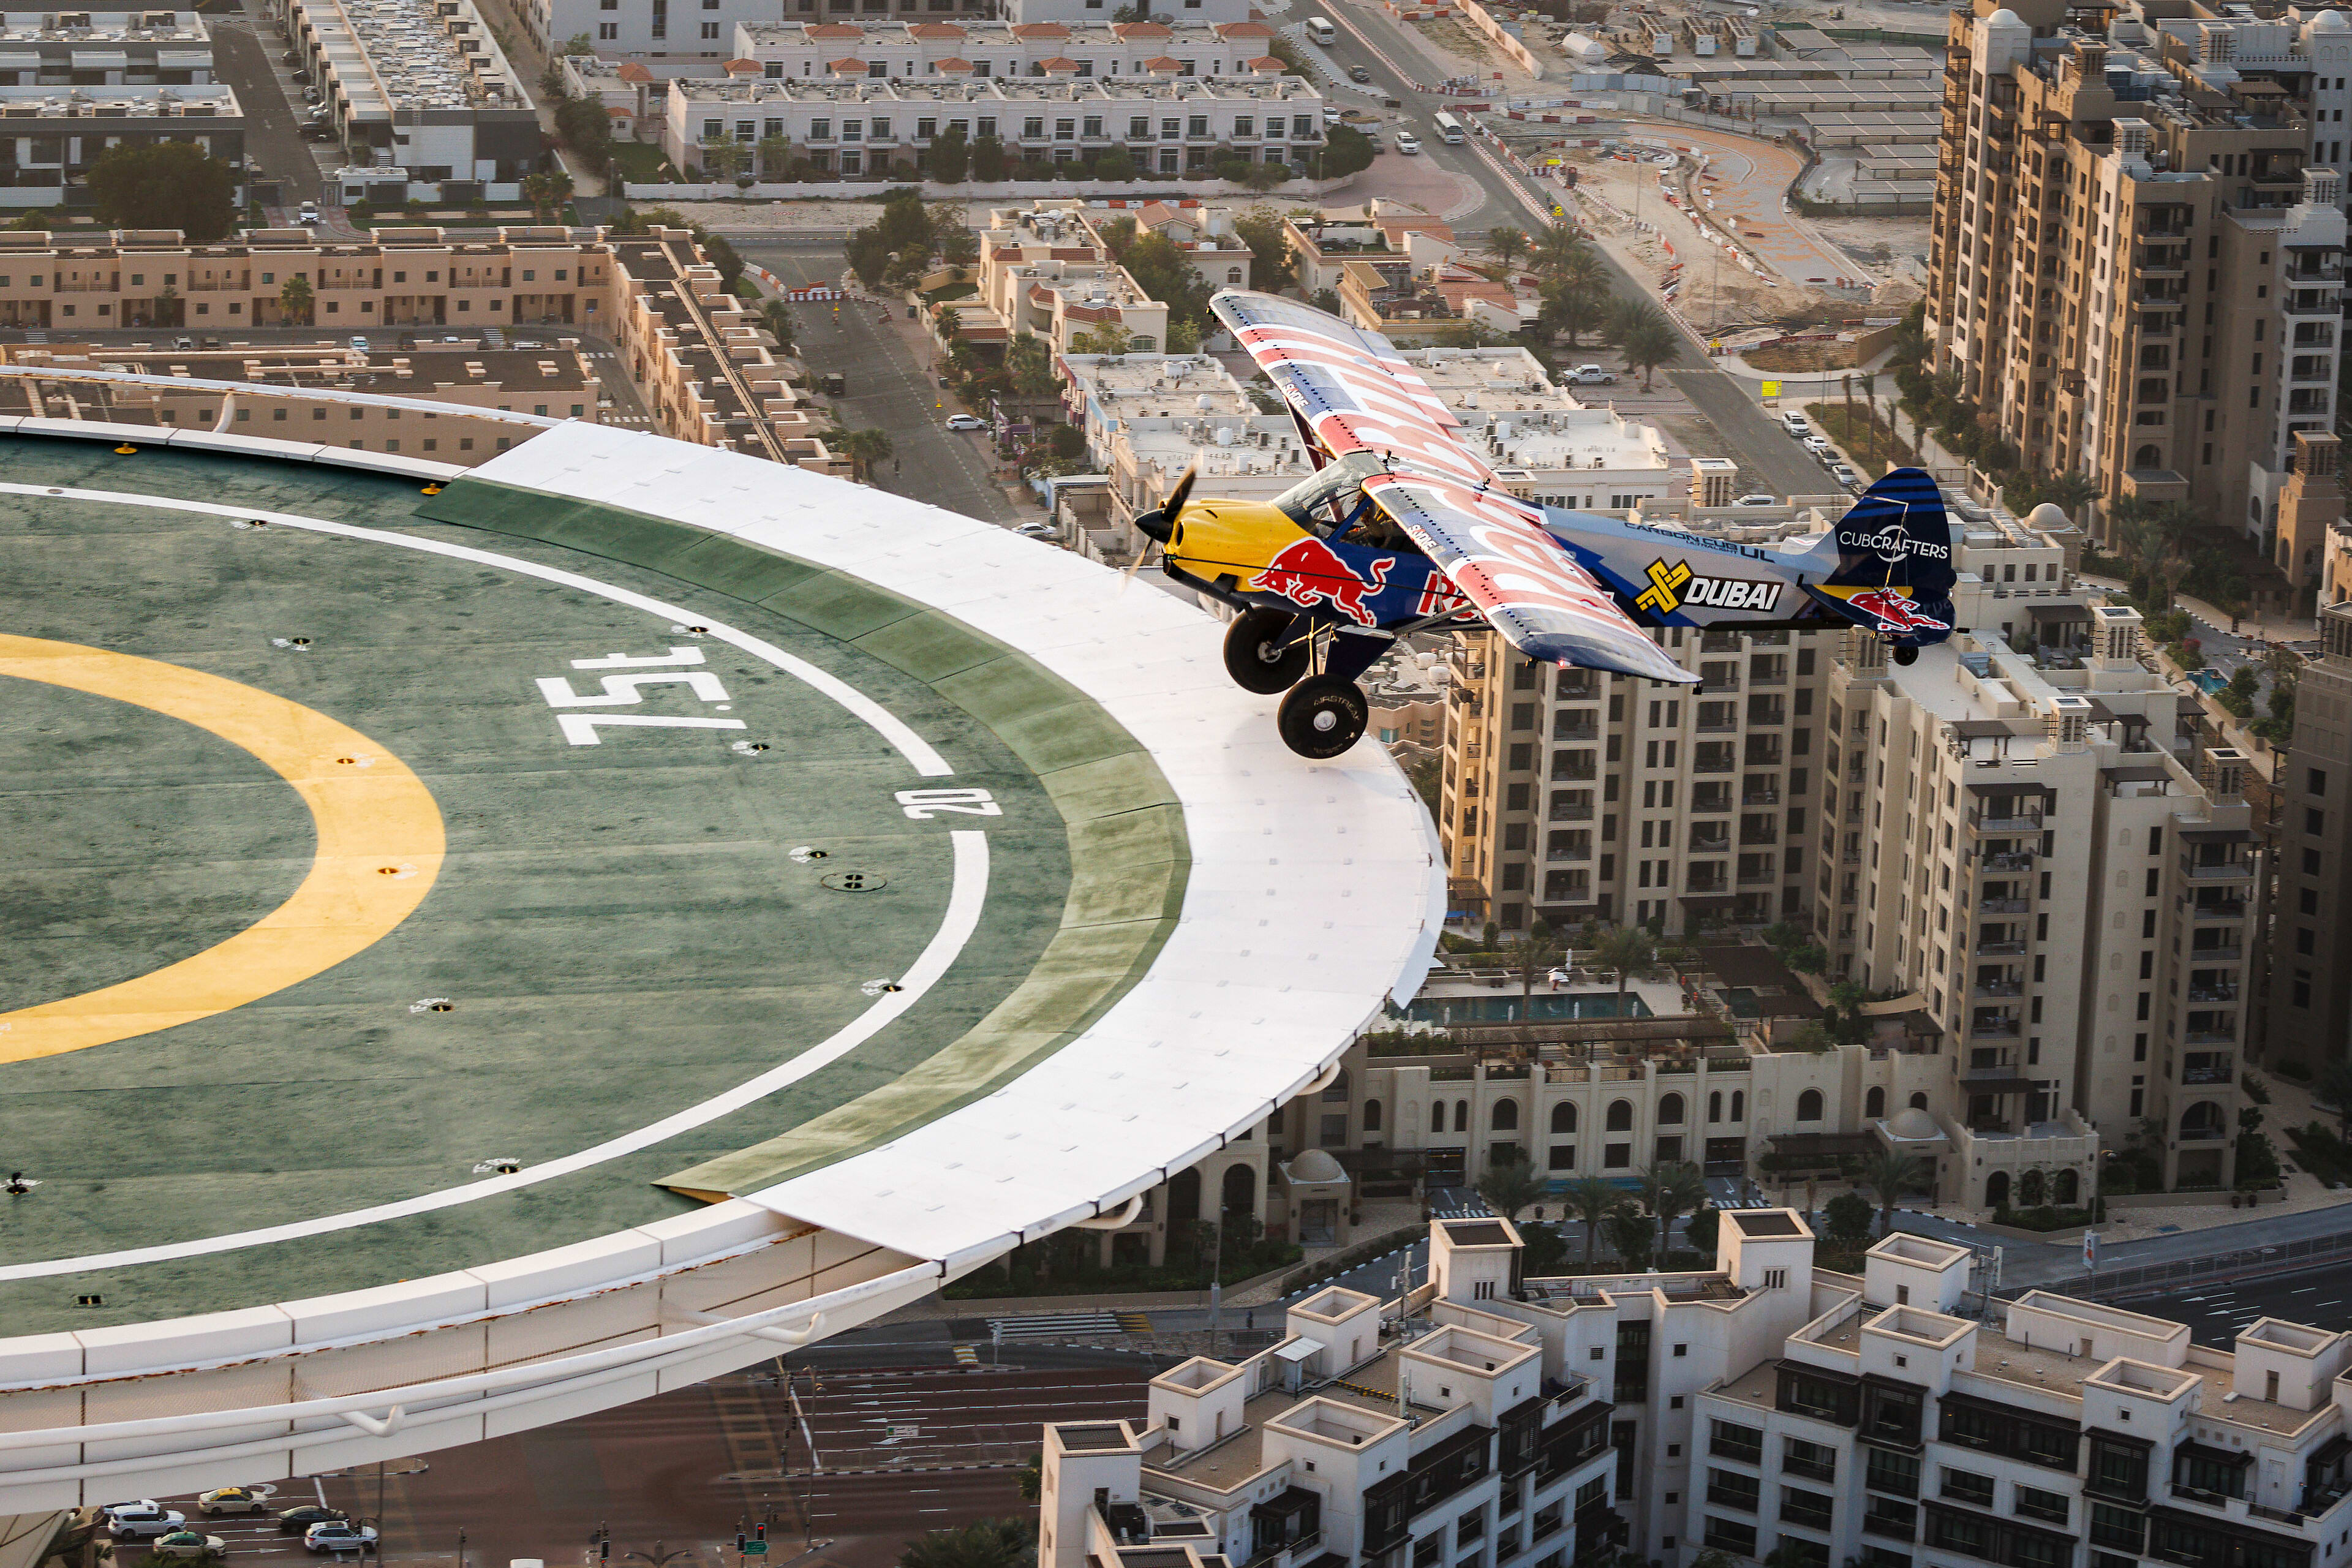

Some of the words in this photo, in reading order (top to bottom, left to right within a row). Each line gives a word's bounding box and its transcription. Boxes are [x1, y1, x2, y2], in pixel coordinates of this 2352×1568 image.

[1624, 522, 1699, 543] CARBON
[1703, 538, 1738, 551] CUB
[1740, 546, 1776, 564] UL
[1686, 540, 1738, 555] ULTRALIGHT
[1839, 531, 1948, 559] CUBCRAFTERS
[1684, 577, 1781, 610] DUBAI
[1314, 695, 1360, 721] AIRSTREAK
[894, 788, 1005, 820] 20
